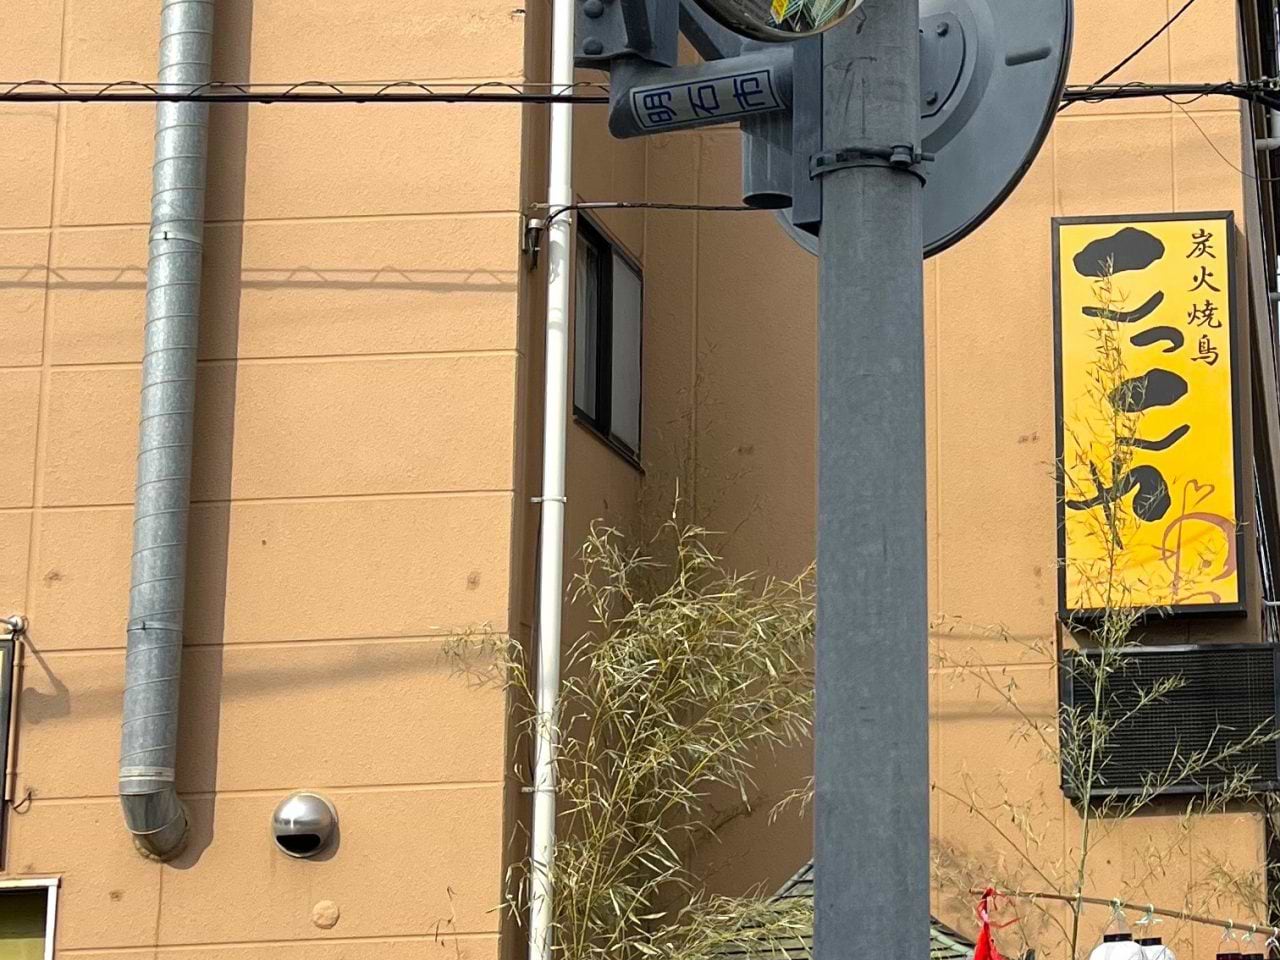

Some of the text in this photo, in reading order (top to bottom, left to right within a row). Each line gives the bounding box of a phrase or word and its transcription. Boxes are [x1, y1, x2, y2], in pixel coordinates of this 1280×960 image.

[643, 77, 766, 124] 明石市
[1186, 229, 1222, 366] 炭火焼鳥
